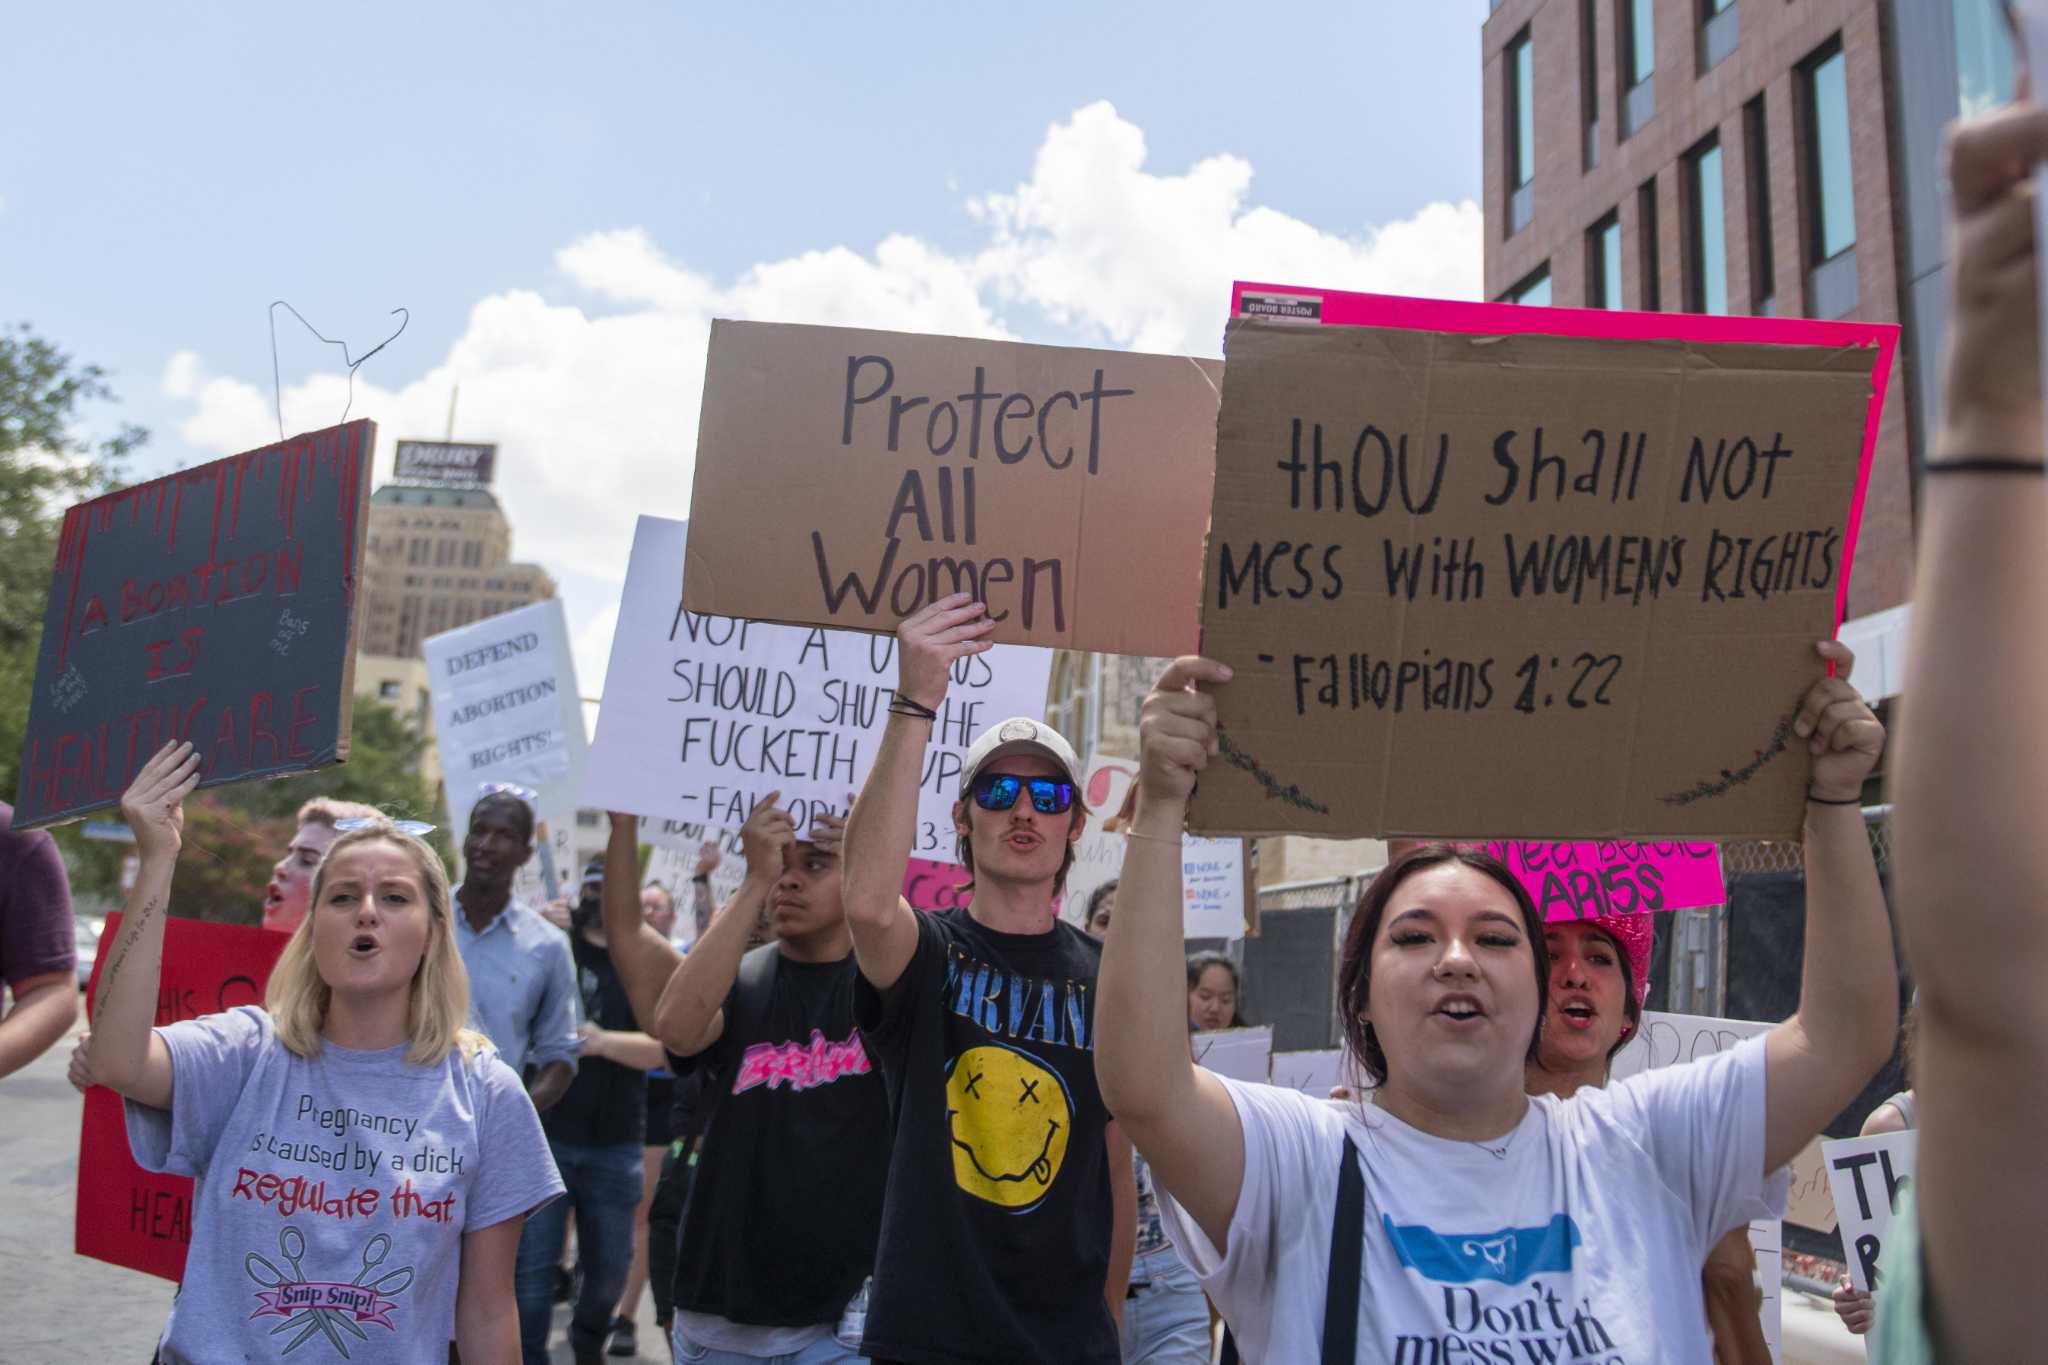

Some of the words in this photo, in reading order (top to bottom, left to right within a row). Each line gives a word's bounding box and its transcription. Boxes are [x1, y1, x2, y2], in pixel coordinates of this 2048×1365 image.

[841, 355, 1135, 474] Protect
[1484, 427, 1648, 506] Shall
[885, 466, 977, 546] All
[811, 531, 1066, 634] Women
[143, 626, 207, 679] IS
[445, 632, 539, 677] DEFEND
[798, 628, 830, 672] A
[869, 632, 993, 688] UUS
[449, 678, 557, 727] ABORTION
[667, 659, 797, 719] SHOULD
[1513, 651, 1623, 714] 1:22
[681, 717, 858, 785] FUCKETH
[297, 1094, 419, 1142] Pregnancy
[354, 1141, 383, 1178] by
[391, 1154, 405, 1171] a
[232, 1167, 381, 1218] Regulate
[282, 1286, 322, 1307] Snip
[326, 1286, 374, 1312] Snip!
[1442, 1281, 1568, 1335] Don't
[1394, 1333, 1516, 1365] mess
